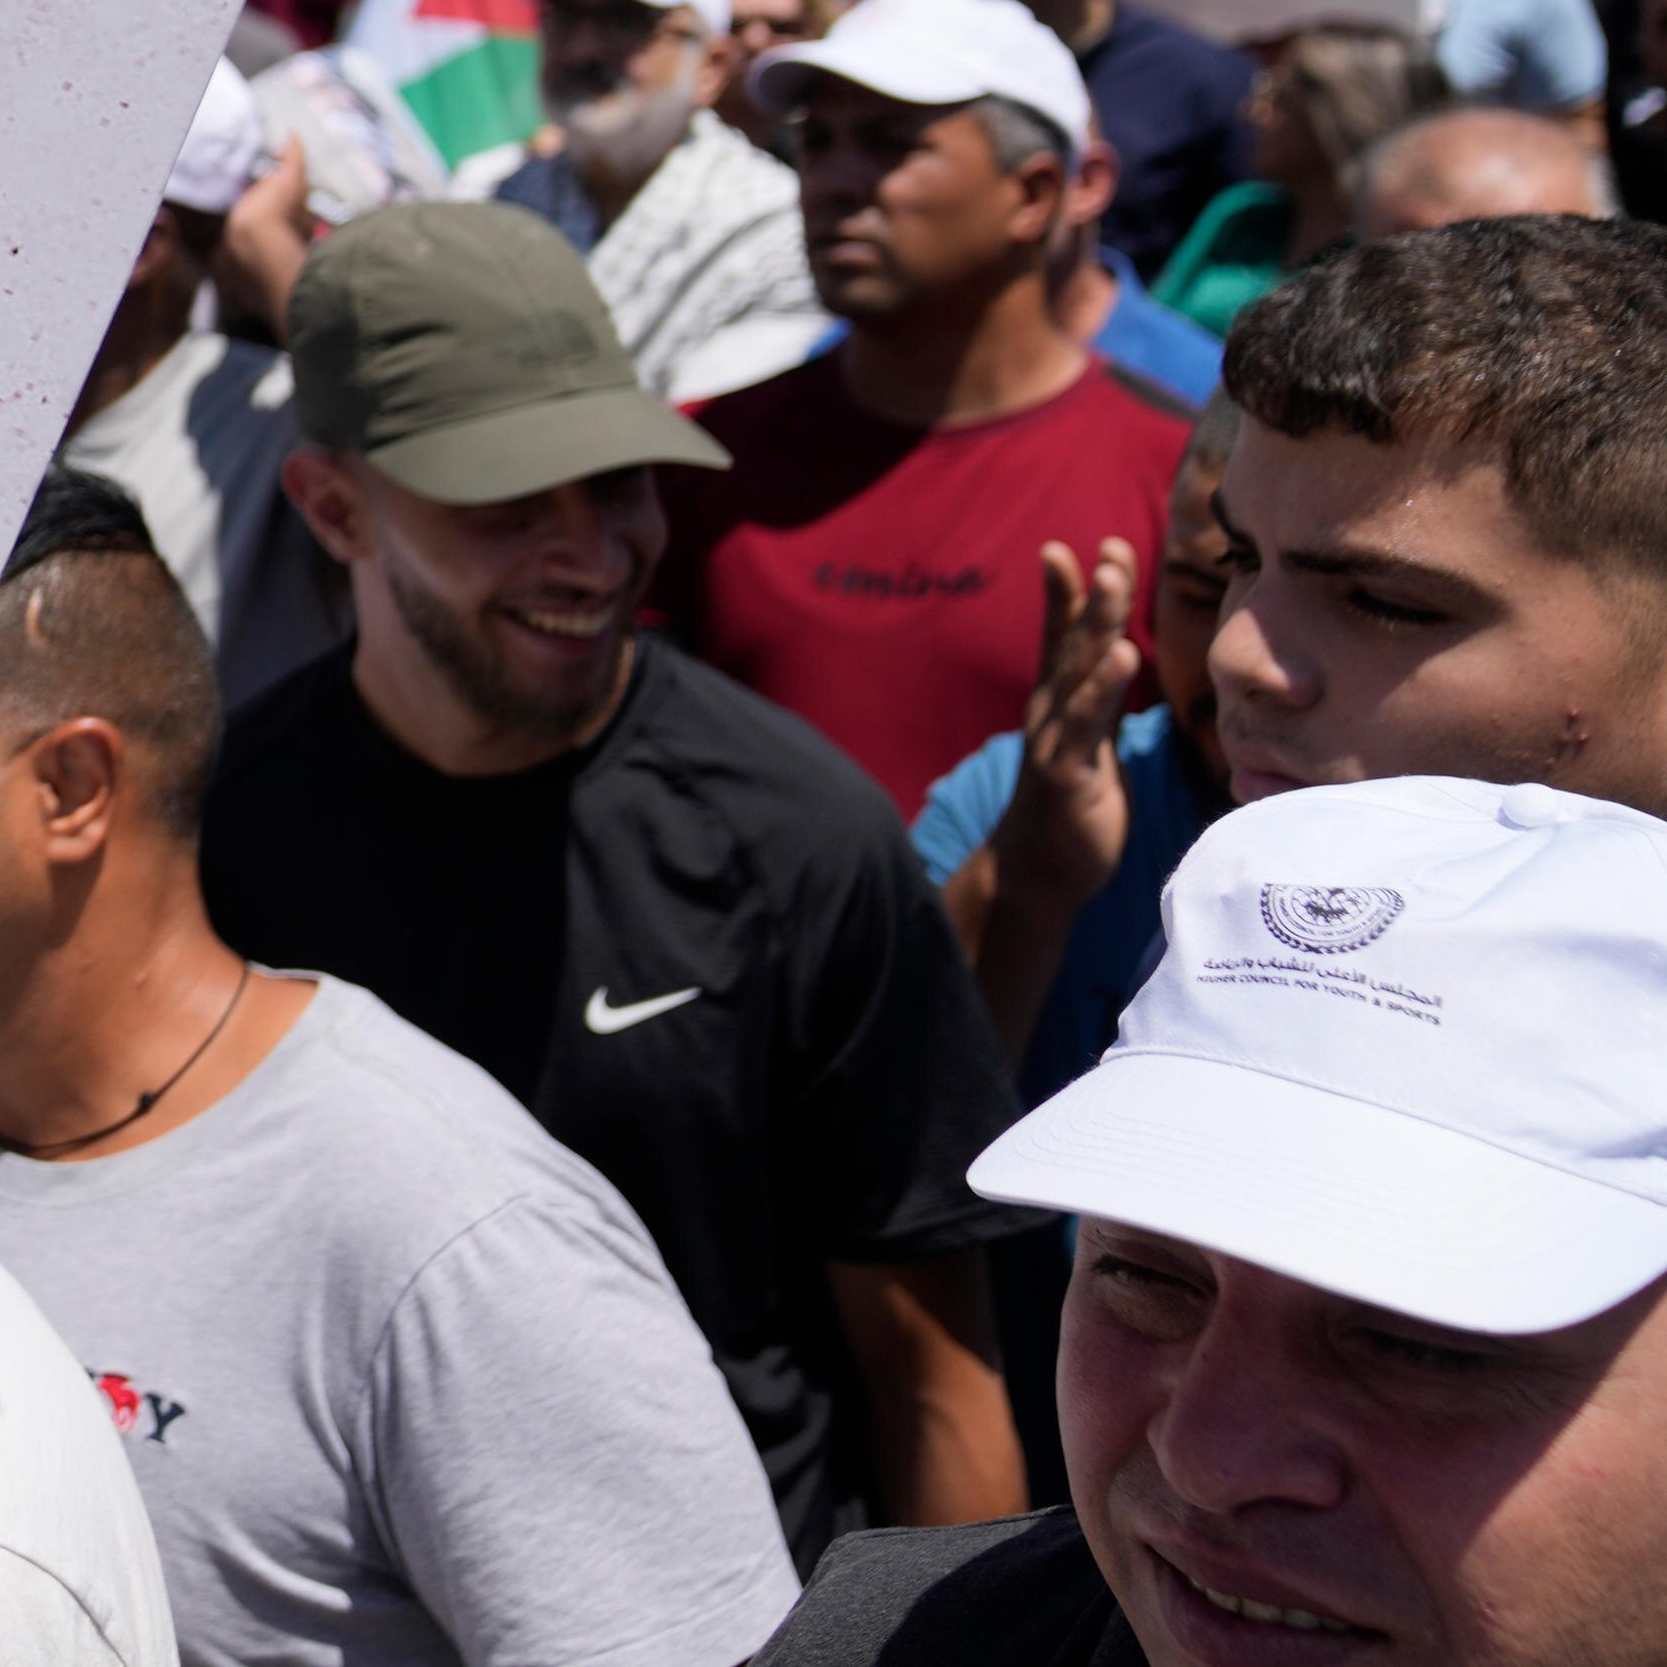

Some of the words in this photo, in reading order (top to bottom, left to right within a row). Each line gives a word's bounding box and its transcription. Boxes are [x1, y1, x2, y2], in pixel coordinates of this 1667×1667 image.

[1239, 974, 1289, 987] COUNCIL
[1294, 979, 1319, 991] FOR
[1386, 1000, 1441, 1026] SPORTS
